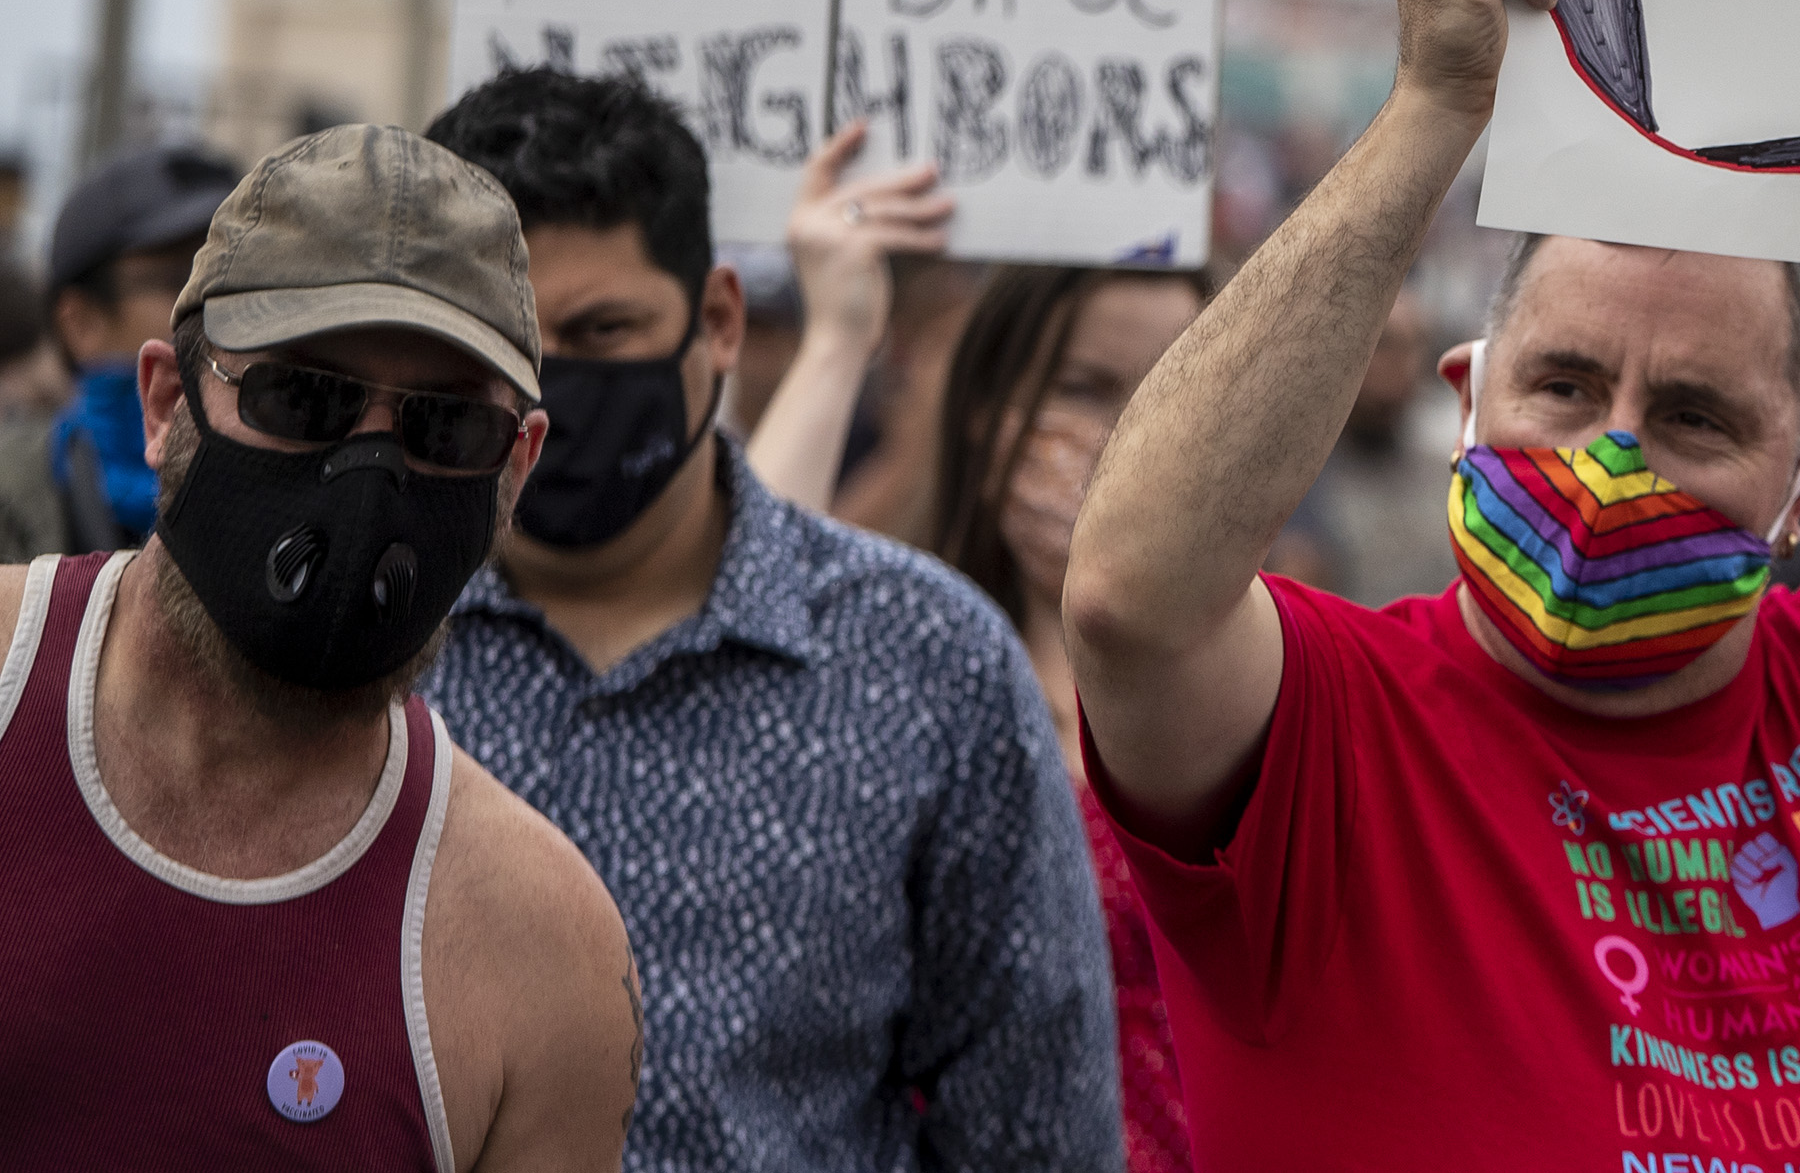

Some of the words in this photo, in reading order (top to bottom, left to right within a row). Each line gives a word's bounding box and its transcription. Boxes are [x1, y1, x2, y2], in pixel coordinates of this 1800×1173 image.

[1563, 839, 1614, 881] NO
[1575, 879, 1616, 923] IS
[1610, 1024, 1760, 1090] KINDNESS
[1615, 1081, 1712, 1143] LOVE
